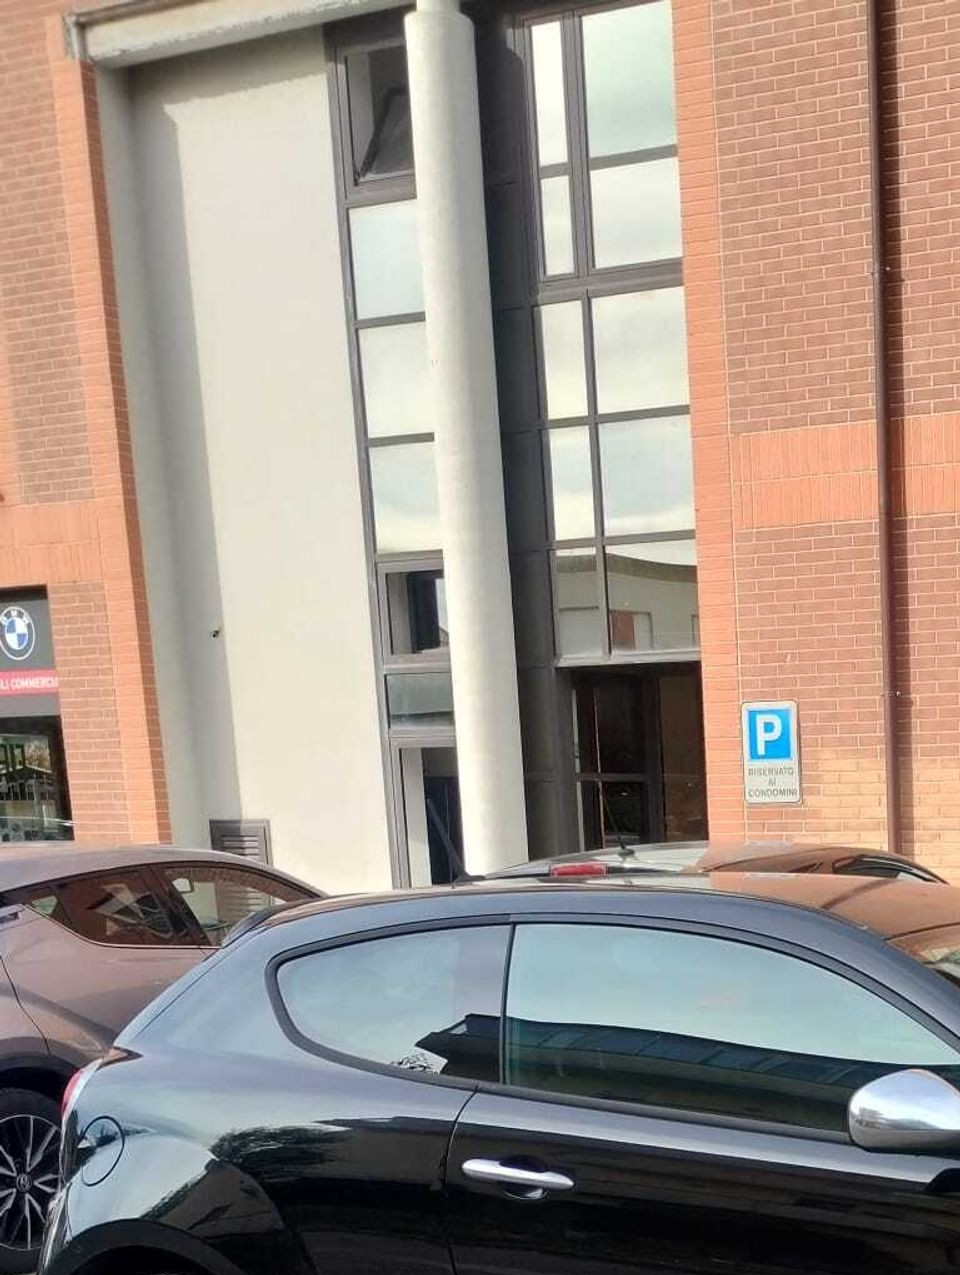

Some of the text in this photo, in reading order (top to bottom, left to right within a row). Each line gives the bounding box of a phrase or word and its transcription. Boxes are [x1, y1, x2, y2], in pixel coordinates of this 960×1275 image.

[756, 714, 782, 756] P
[748, 767, 794, 776] RISERVATO
[748, 788, 797, 798] CONDOMINI
